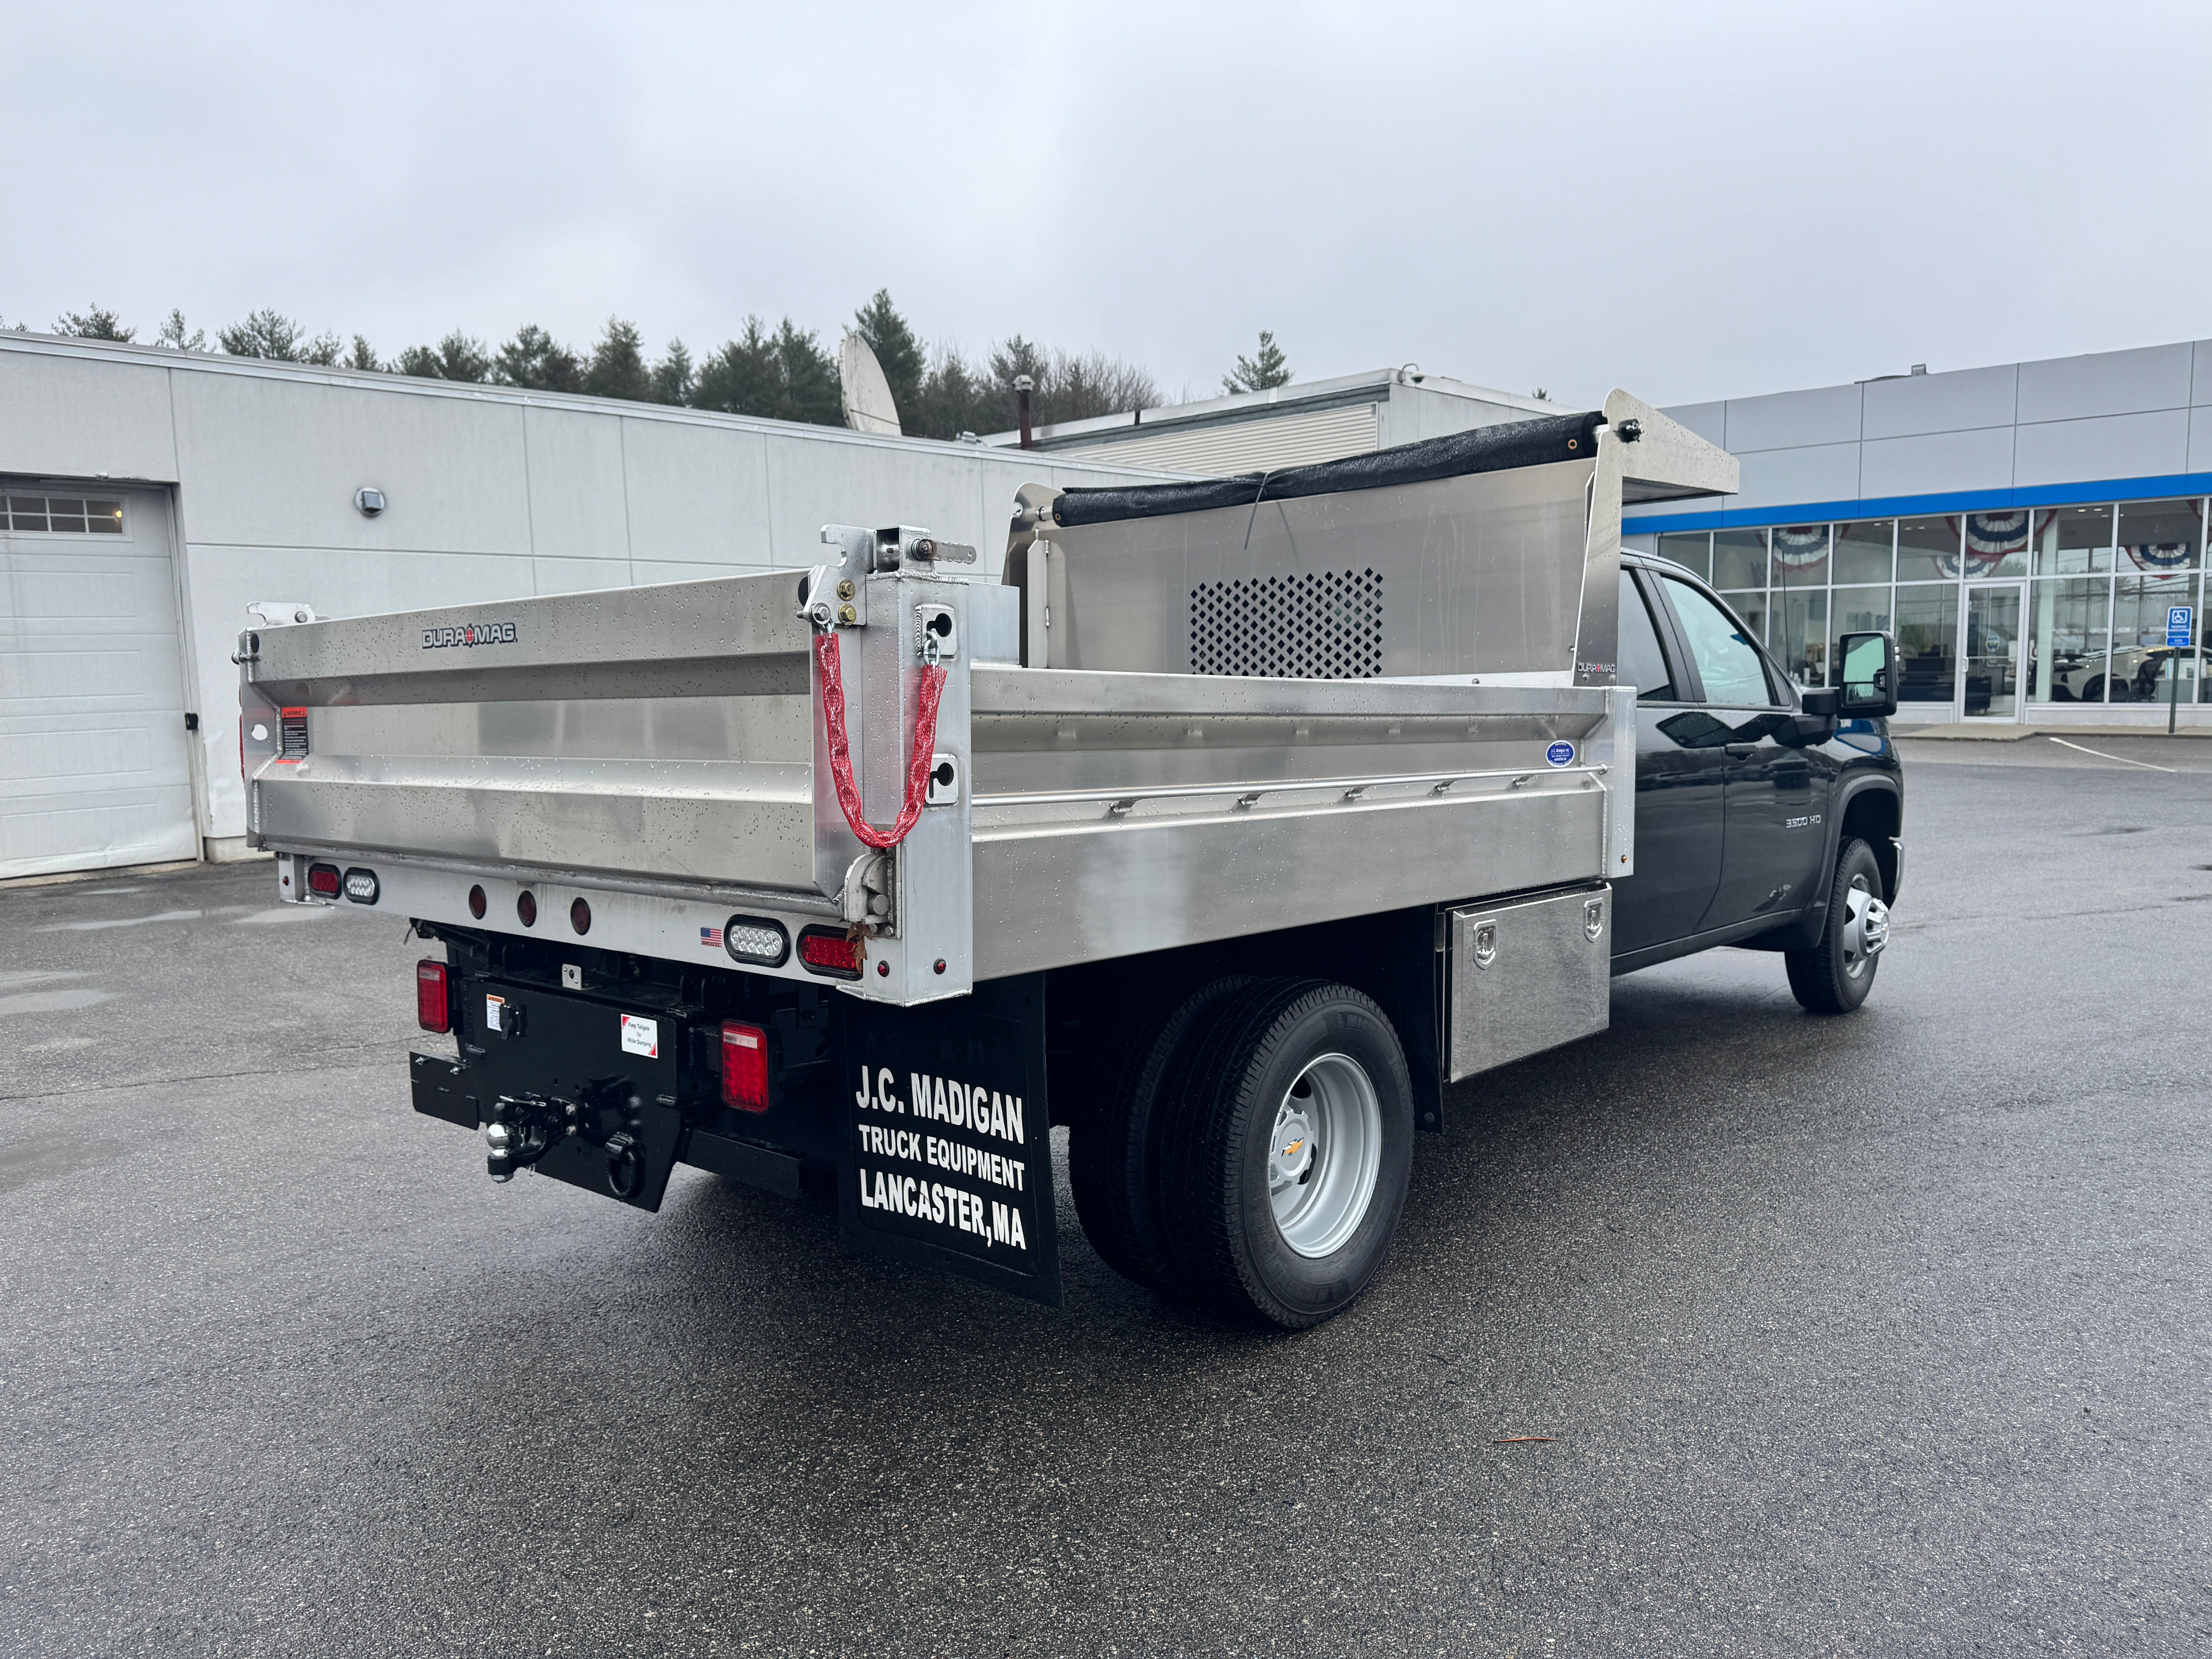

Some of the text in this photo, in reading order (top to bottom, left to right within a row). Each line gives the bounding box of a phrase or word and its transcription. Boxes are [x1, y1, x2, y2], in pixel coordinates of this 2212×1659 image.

[1786, 814, 1821, 828] 3500 HD
[637, 1039, 652, 1048] Dumping
[856, 1065, 1024, 1144] J.C. MADIGAN
[859, 1124, 1025, 1192] TRUCK EQUIPMENT
